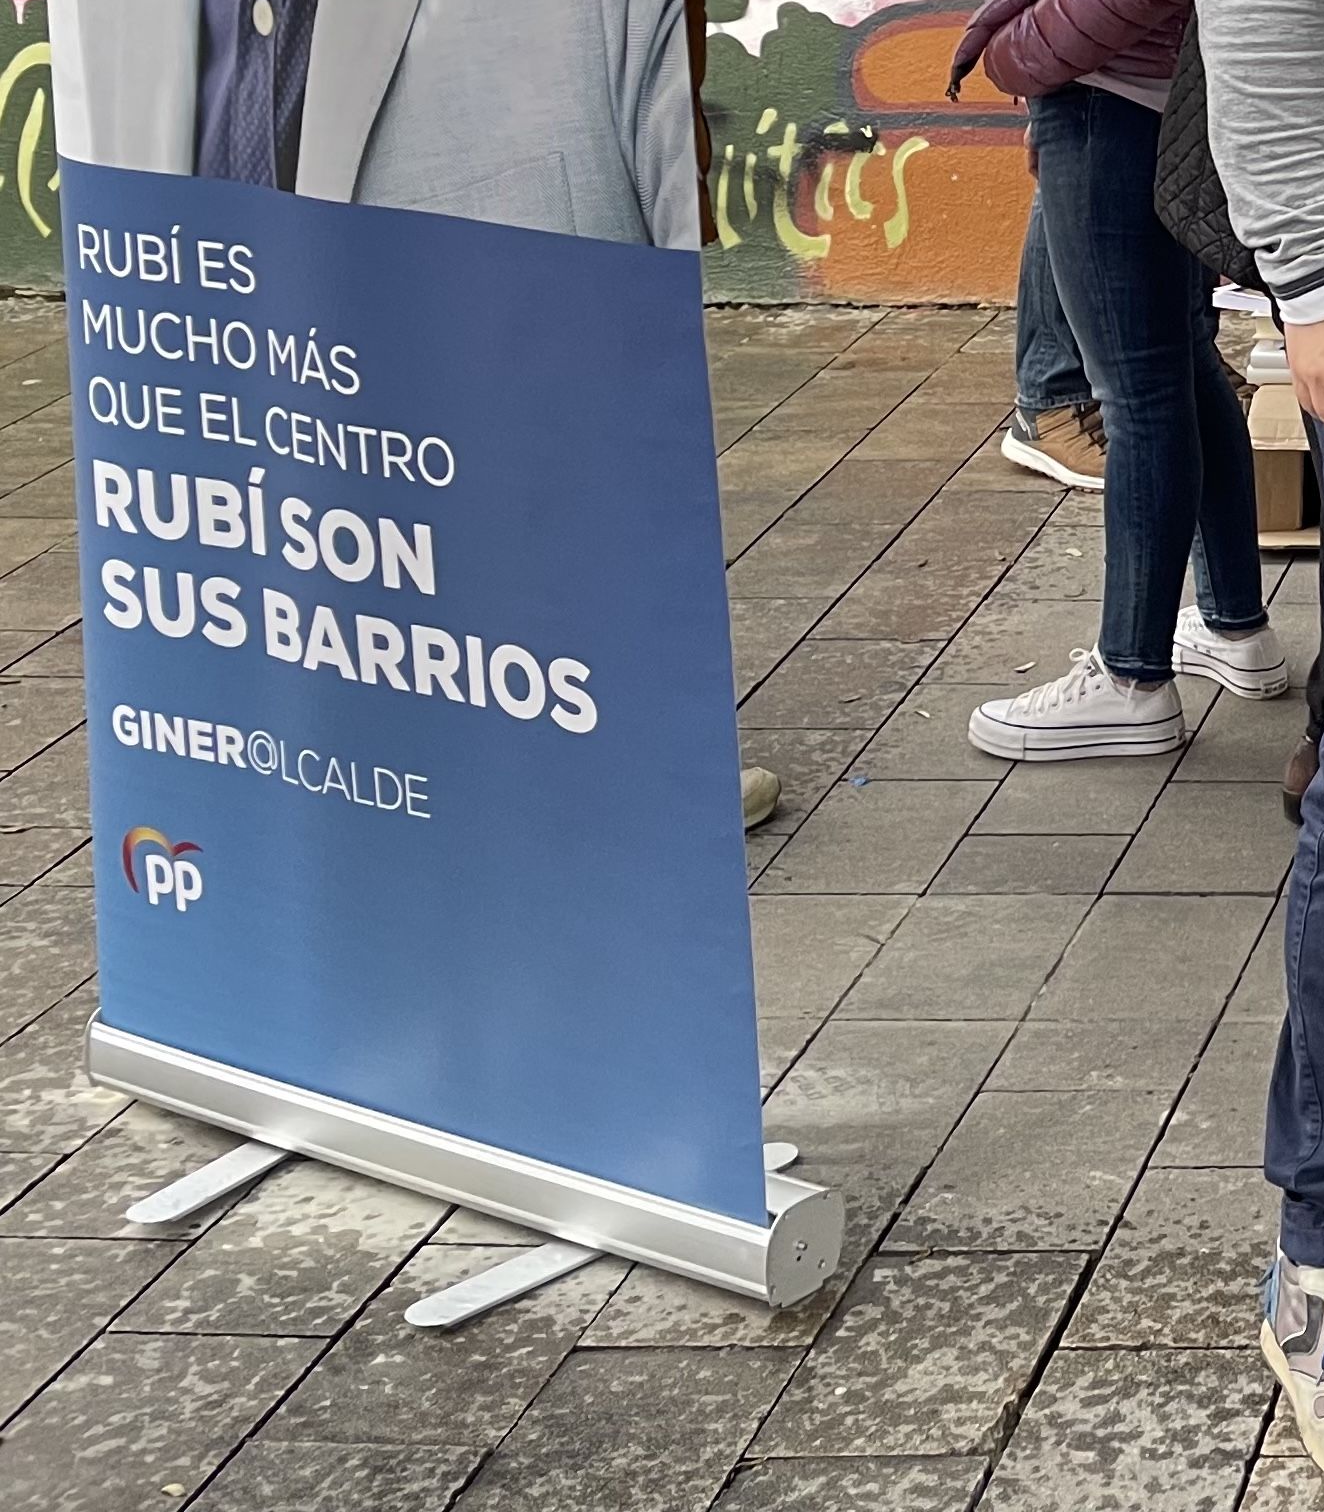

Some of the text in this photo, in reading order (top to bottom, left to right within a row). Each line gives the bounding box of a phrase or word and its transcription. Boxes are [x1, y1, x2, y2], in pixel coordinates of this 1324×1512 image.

[78, 224, 256, 294] RUBÍ ES
[82, 299, 360, 395] MUCHO MÁS
[88, 376, 455, 487] QUE EL CENTRO
[93, 459, 436, 596] RUBÍ SON
[101, 558, 598, 734] SUS BARRIOS
[112, 704, 431, 819] GINER@LCALDE
